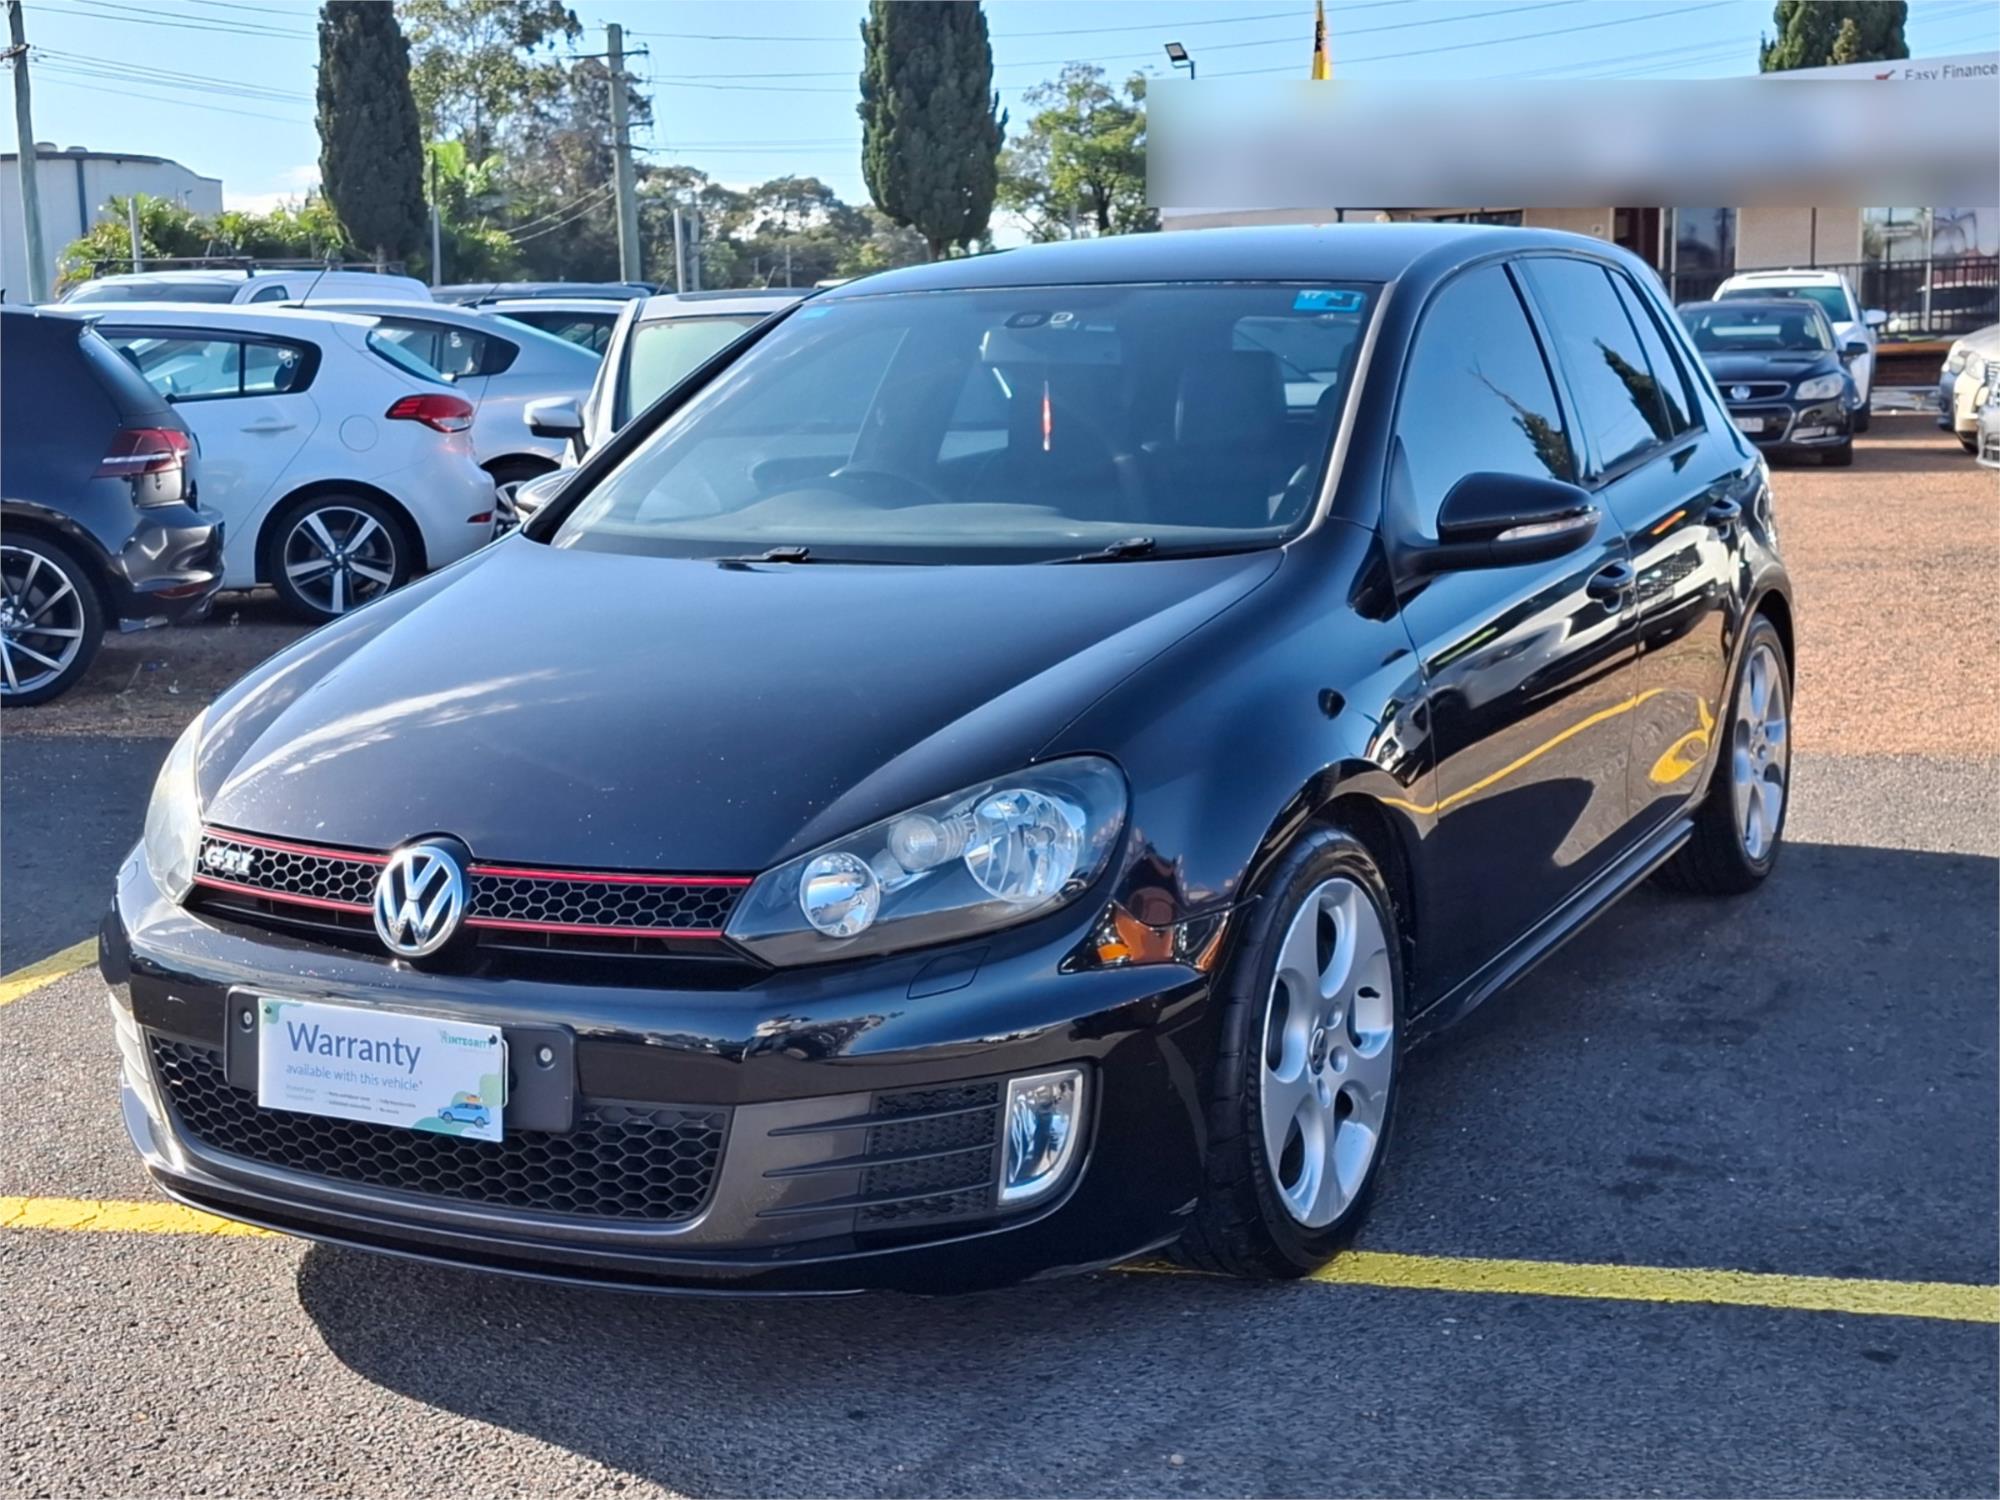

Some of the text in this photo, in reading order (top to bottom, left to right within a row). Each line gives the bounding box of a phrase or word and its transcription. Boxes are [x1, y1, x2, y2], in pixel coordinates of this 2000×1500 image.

[1942, 63, 1998, 79] Finance
[204, 846, 255, 874] GTI
[287, 1020, 421, 1074] Warranty
[286, 1063, 331, 1080] available
[334, 1068, 357, 1083] with
[360, 1073, 379, 1087] this
